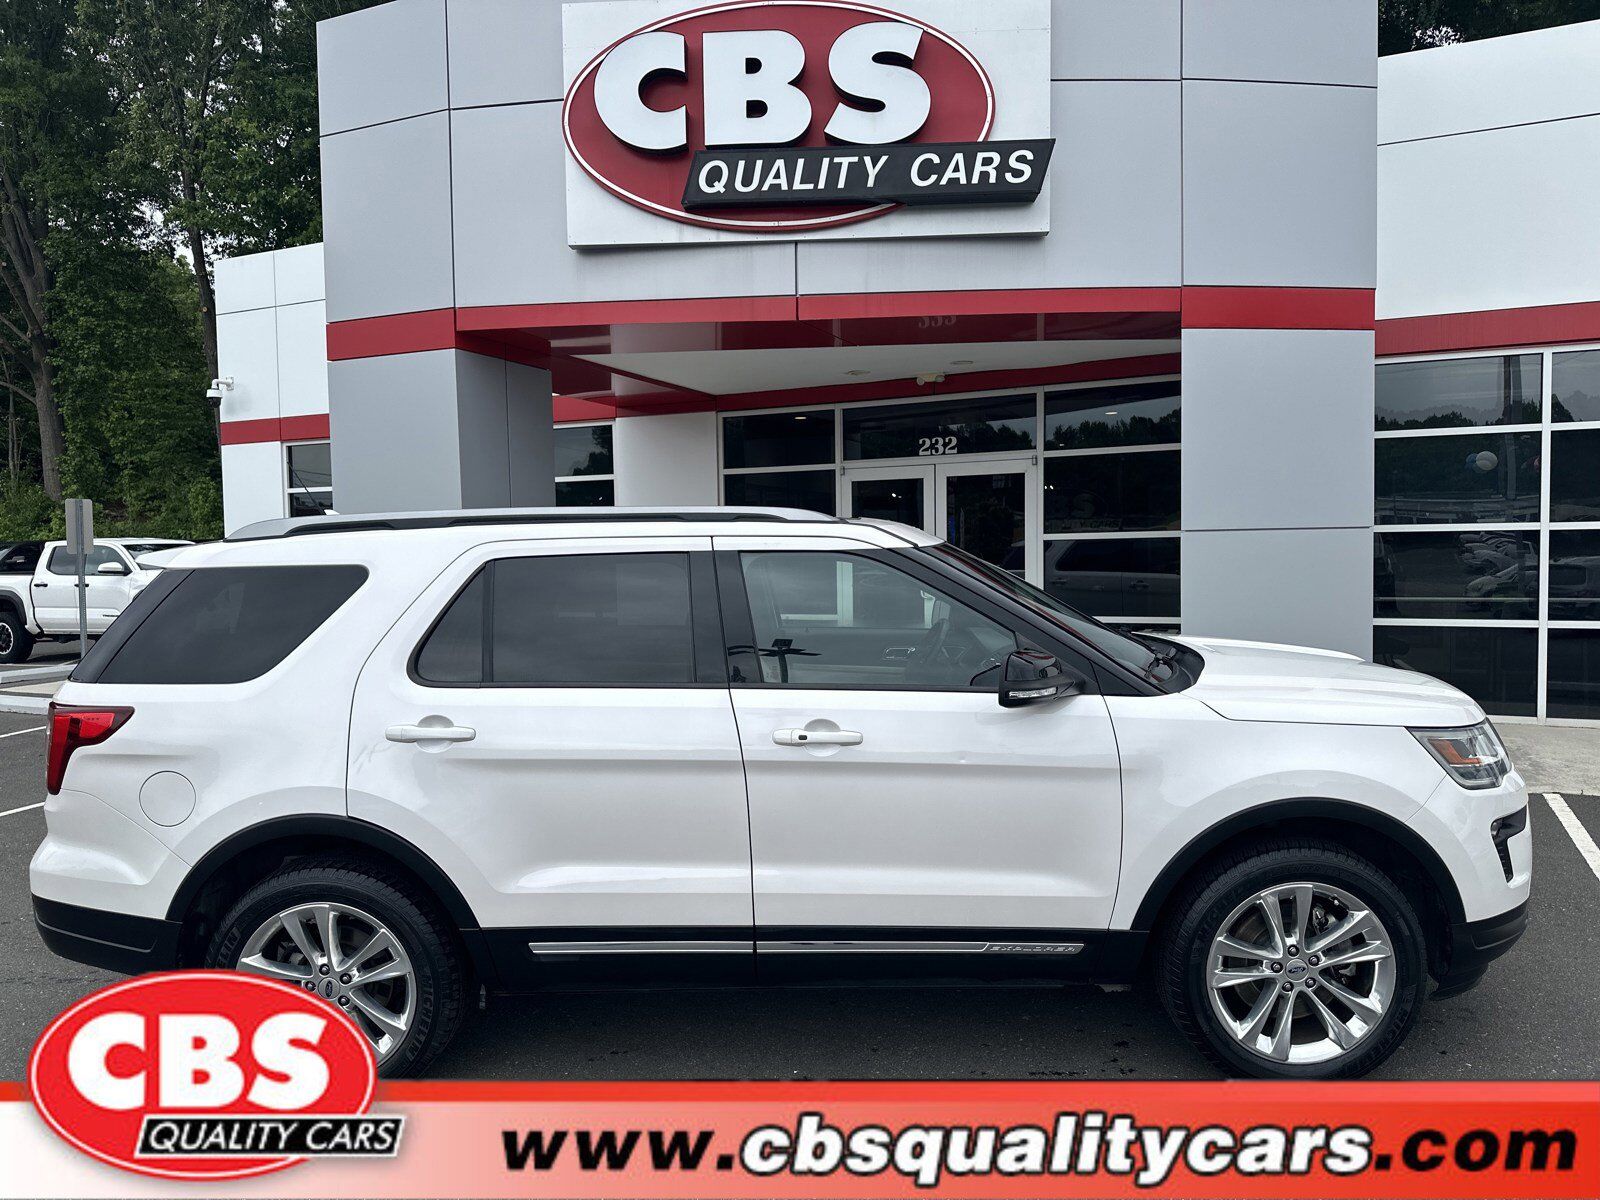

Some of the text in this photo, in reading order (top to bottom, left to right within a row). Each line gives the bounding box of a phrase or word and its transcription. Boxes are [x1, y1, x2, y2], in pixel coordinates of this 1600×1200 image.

[594, 21, 932, 152] CBS
[698, 149, 1034, 194] QUALITY CARS
[918, 436, 958, 456] 232
